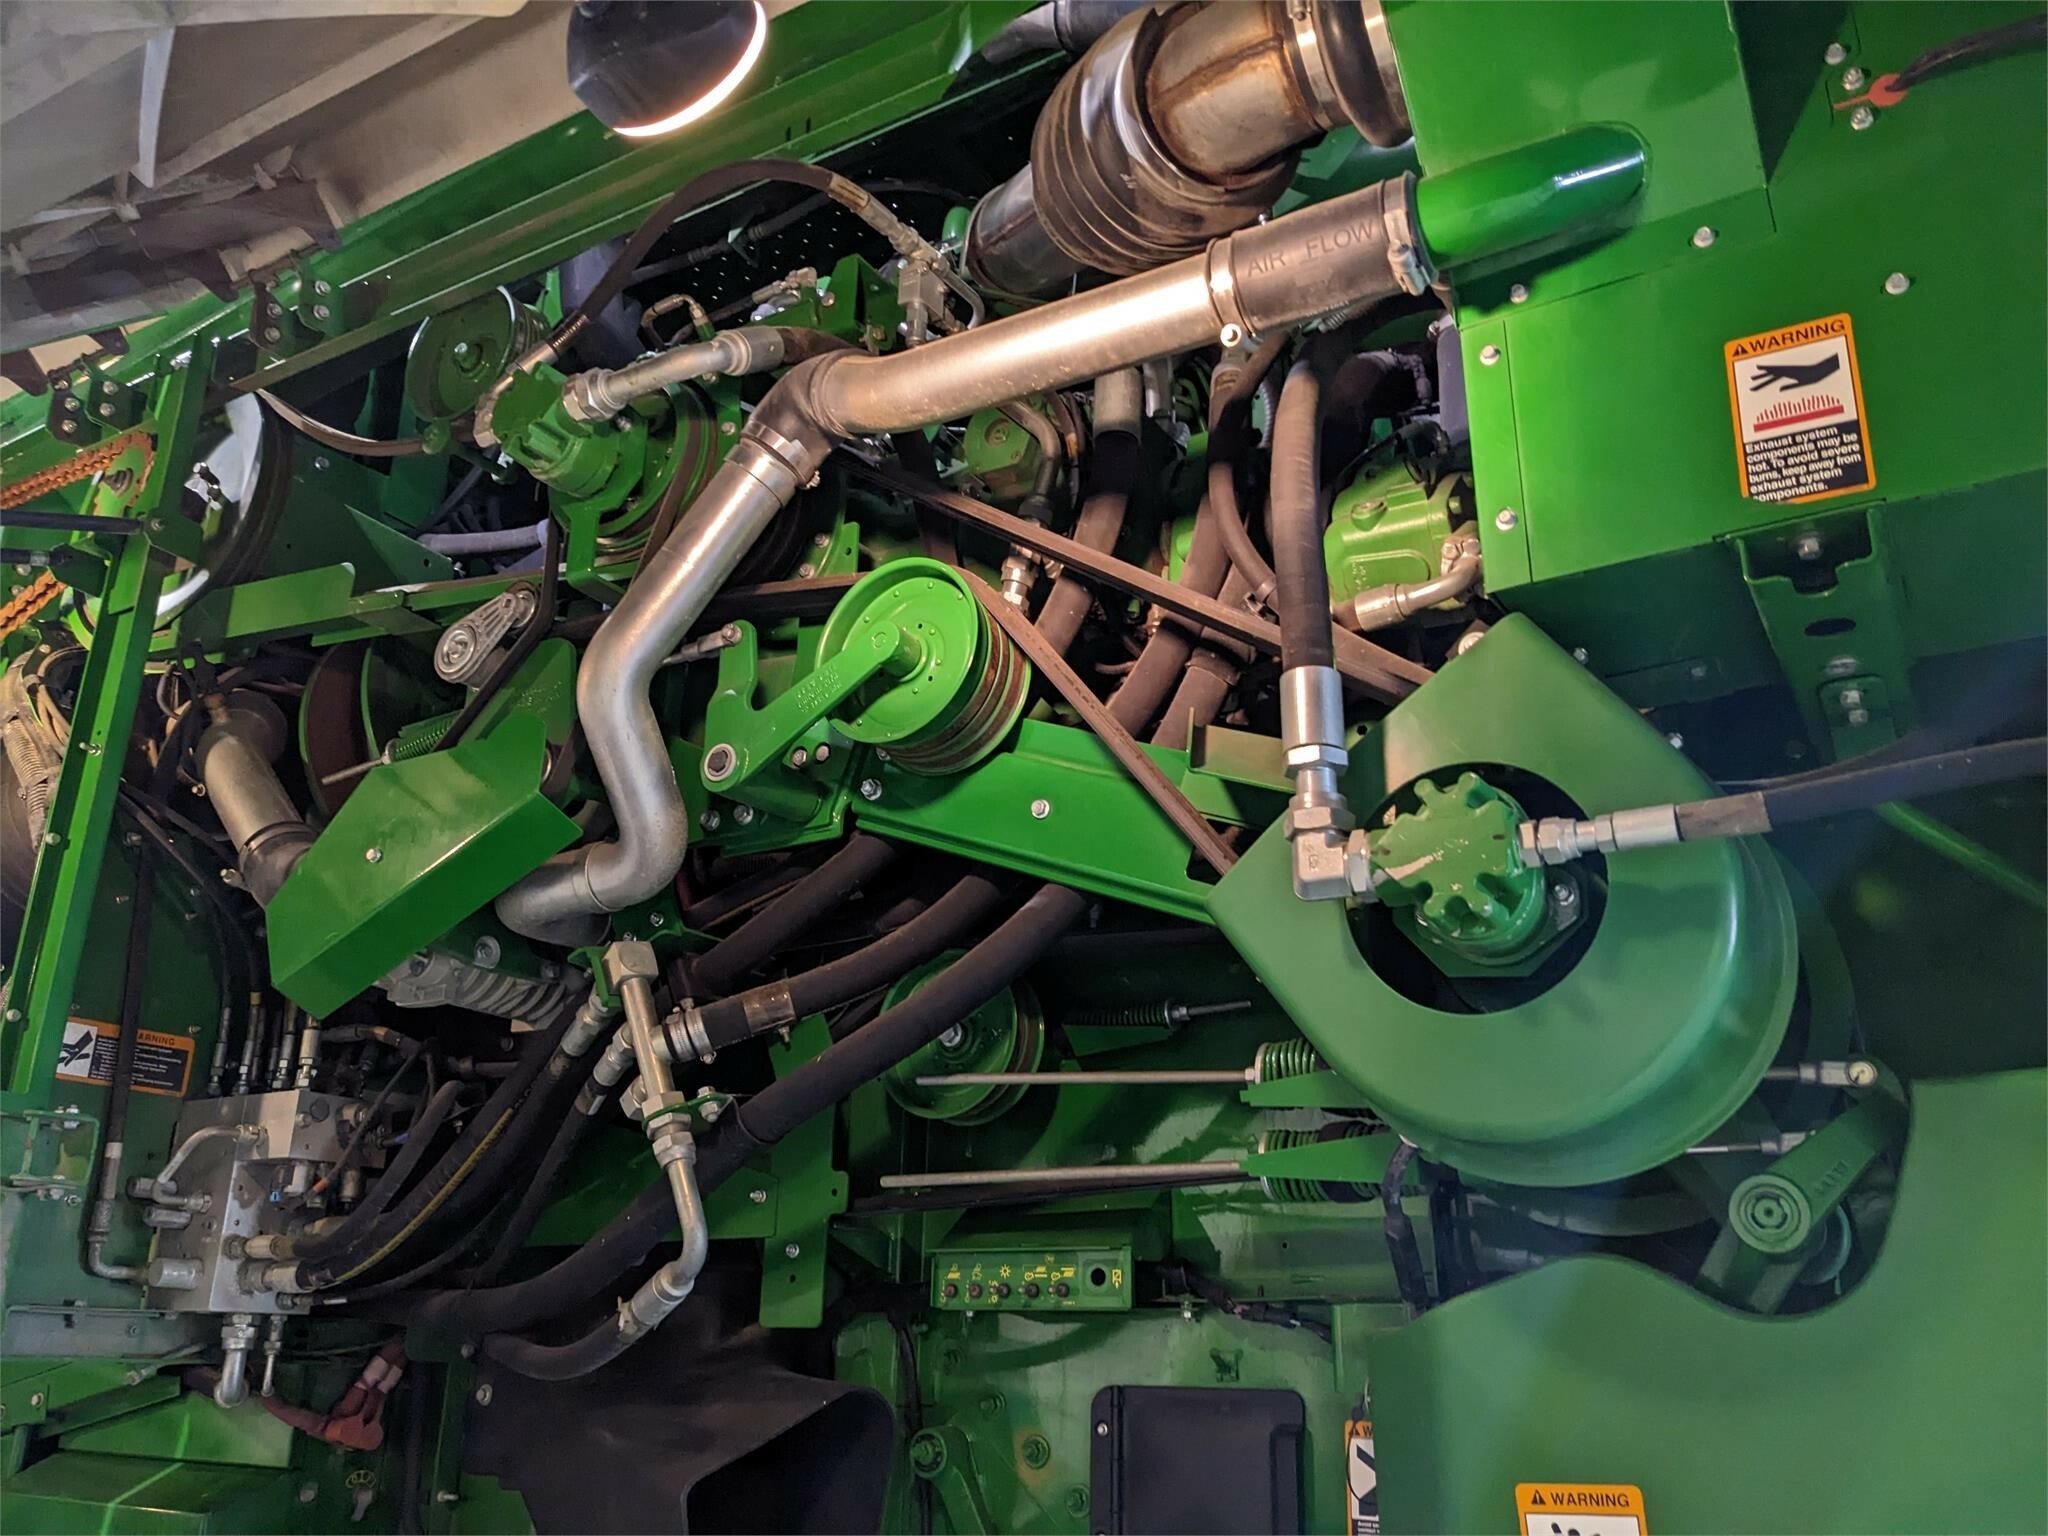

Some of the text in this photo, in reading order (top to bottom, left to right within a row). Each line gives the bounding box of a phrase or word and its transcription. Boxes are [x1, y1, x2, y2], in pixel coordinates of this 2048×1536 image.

[1248, 220, 1374, 276] AIR FLOW
[1749, 319, 1845, 352] WARNING
[1745, 426, 1838, 453] Exhaust system
[1747, 432, 1858, 464] components may be
[1748, 443, 1860, 474] hot. To avoid severe
[1782, 464, 1807, 479] keep
[1808, 459, 1835, 472] away
[1836, 453, 1862, 466] from
[1750, 467, 1843, 494] exhaust system
[138, 1032, 176, 1046] ARNING
[1551, 1491, 1630, 1508] WARNING
